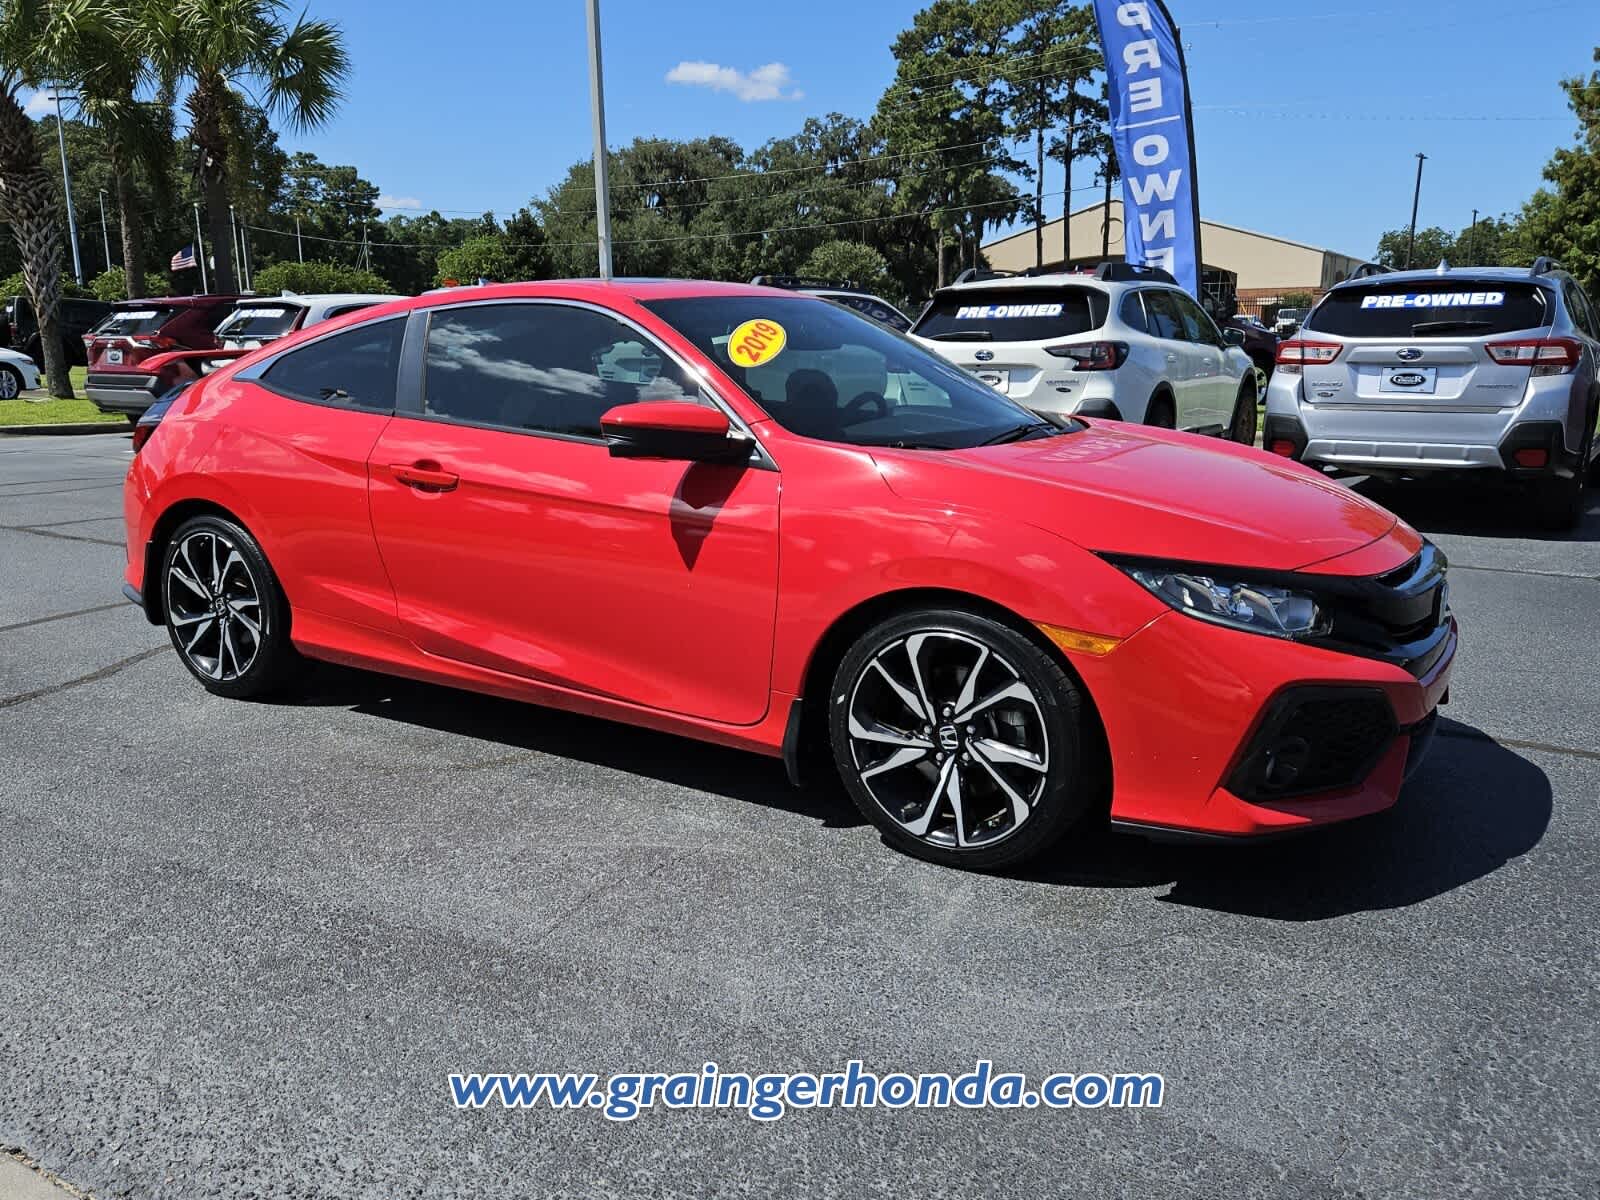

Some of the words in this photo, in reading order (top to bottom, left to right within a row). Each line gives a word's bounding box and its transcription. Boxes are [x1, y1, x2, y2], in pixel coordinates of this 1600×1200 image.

[1360, 292, 1504, 308] PRE-OWNED
[955, 303, 1063, 319] PRE-OWNED
[736, 322, 777, 362] 2019
